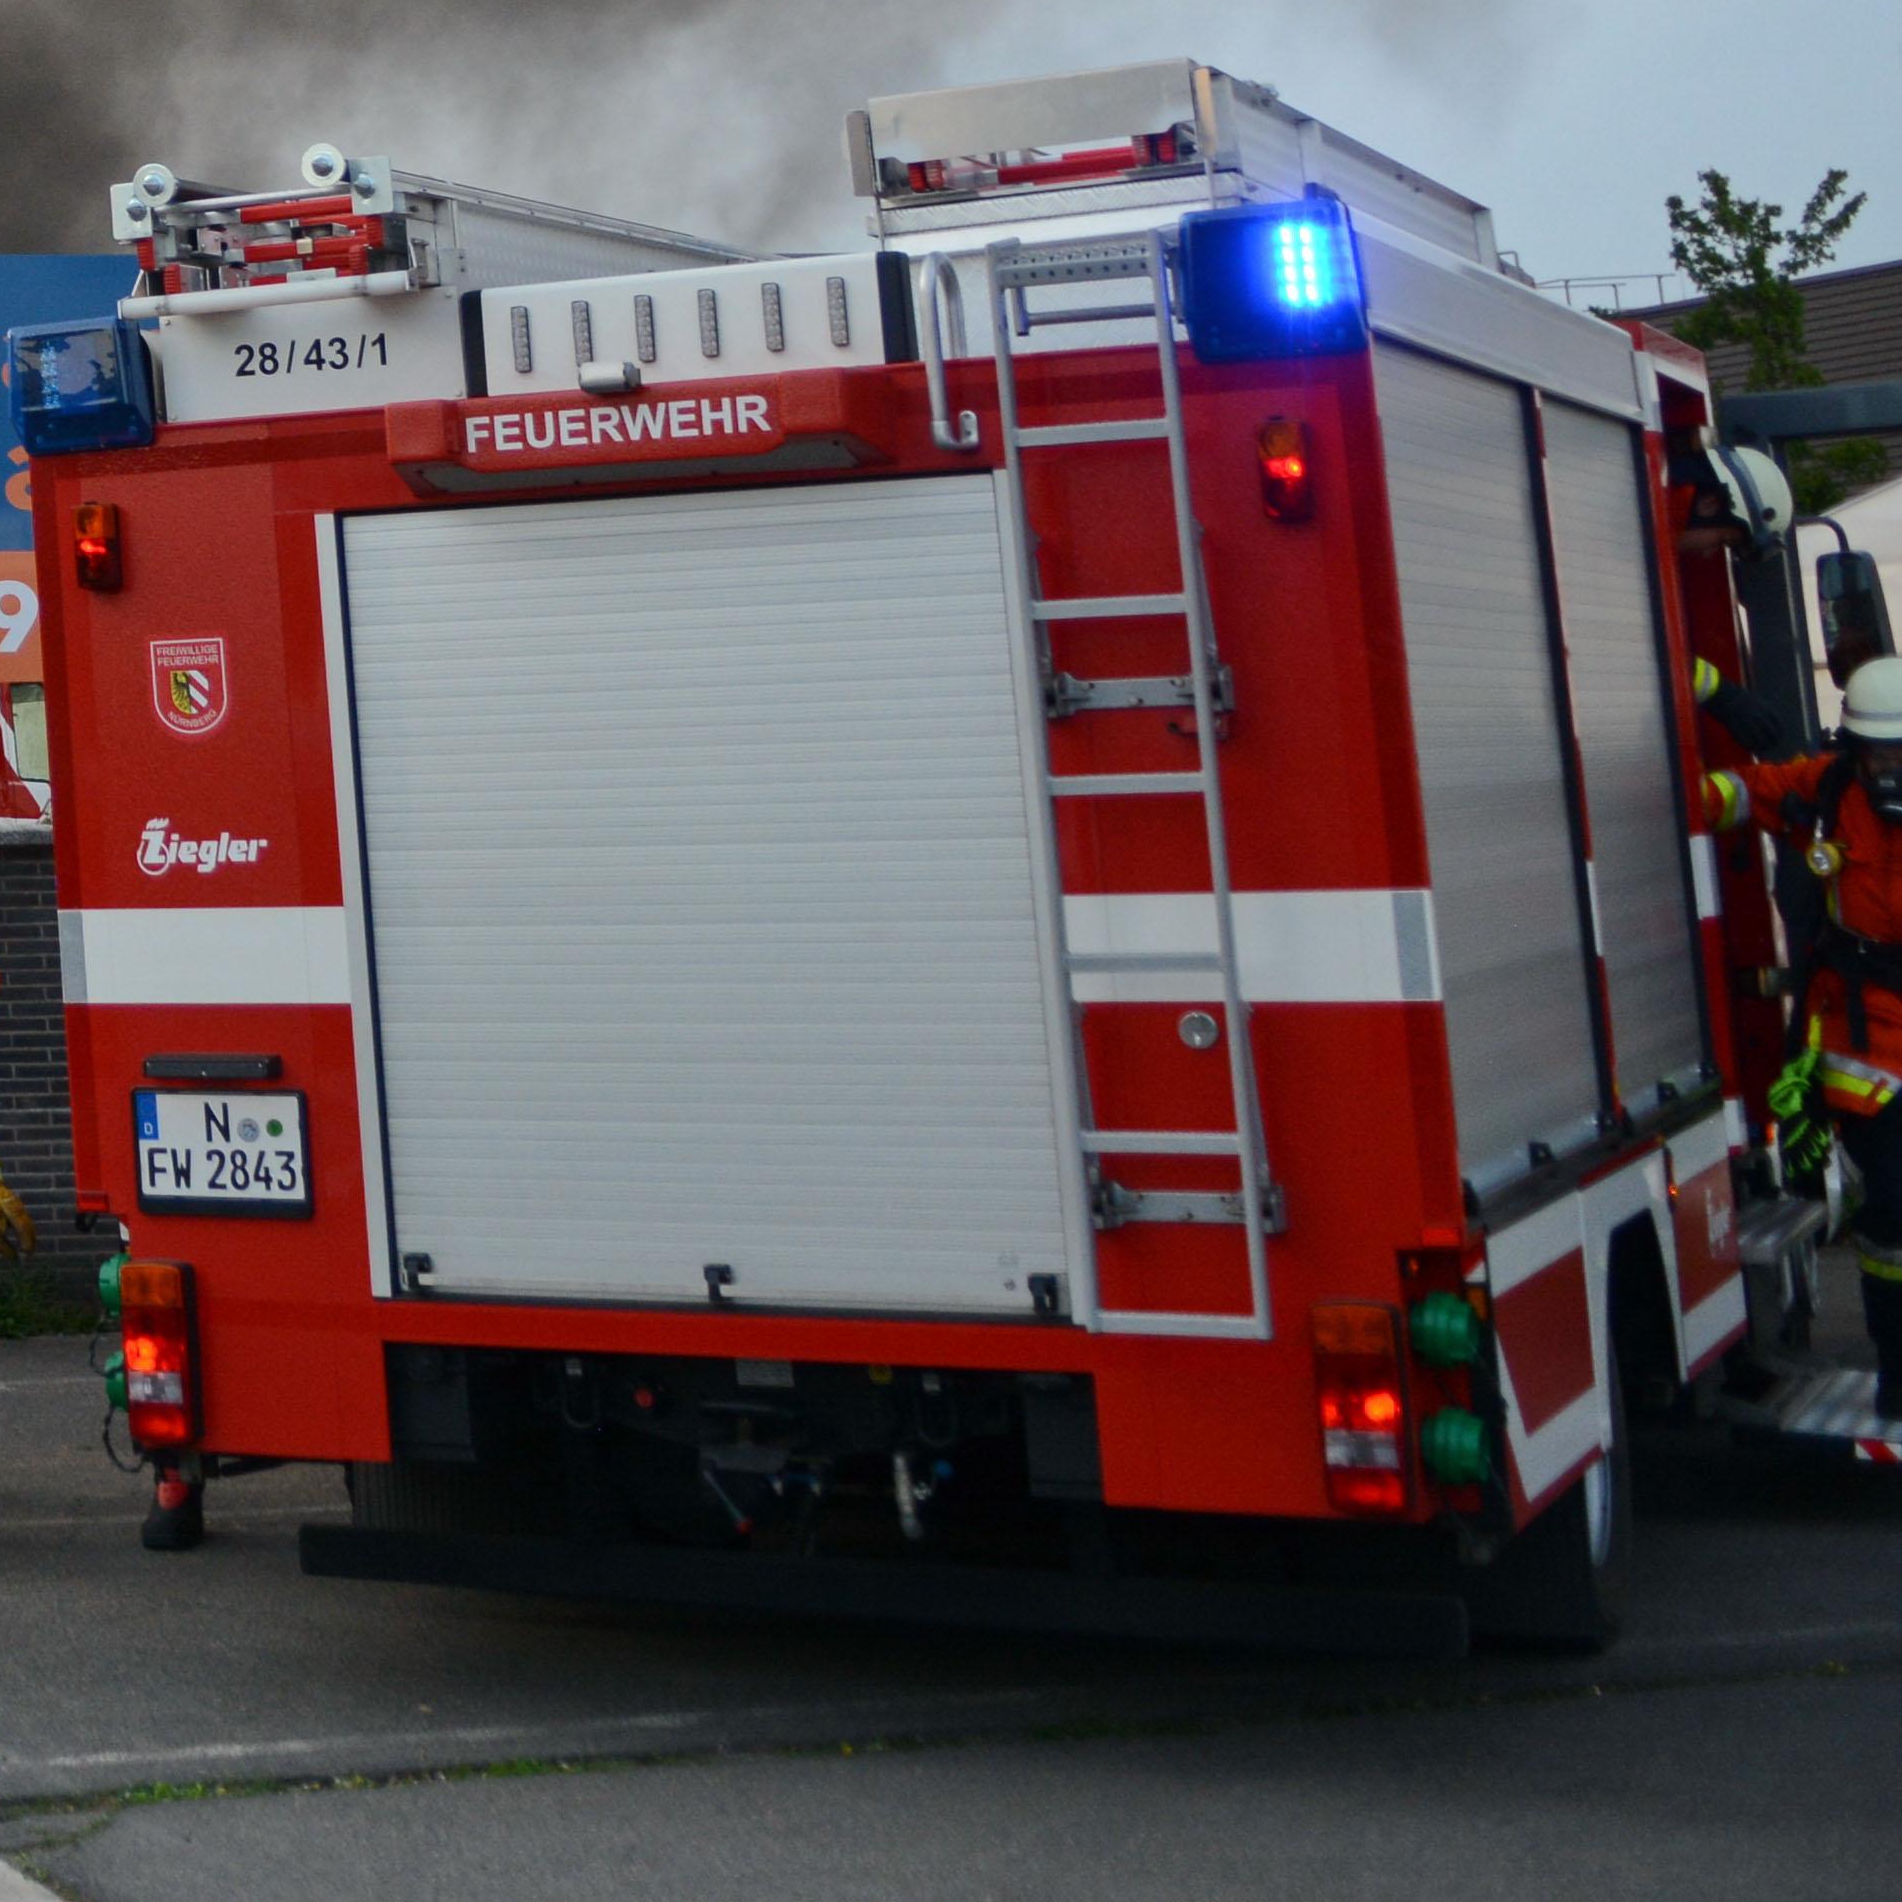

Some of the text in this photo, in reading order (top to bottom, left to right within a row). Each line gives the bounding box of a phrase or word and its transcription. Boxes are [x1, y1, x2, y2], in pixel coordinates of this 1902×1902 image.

[464, 394, 771, 454] FEUERWEHR
[156, 643, 219, 656] FREIWILLIGE
[157, 655, 220, 667] FEUERWEHR
[137, 819, 268, 876] Ziegler
[203, 1101, 231, 1143] N
[147, 1147, 297, 1192] FW 2843
